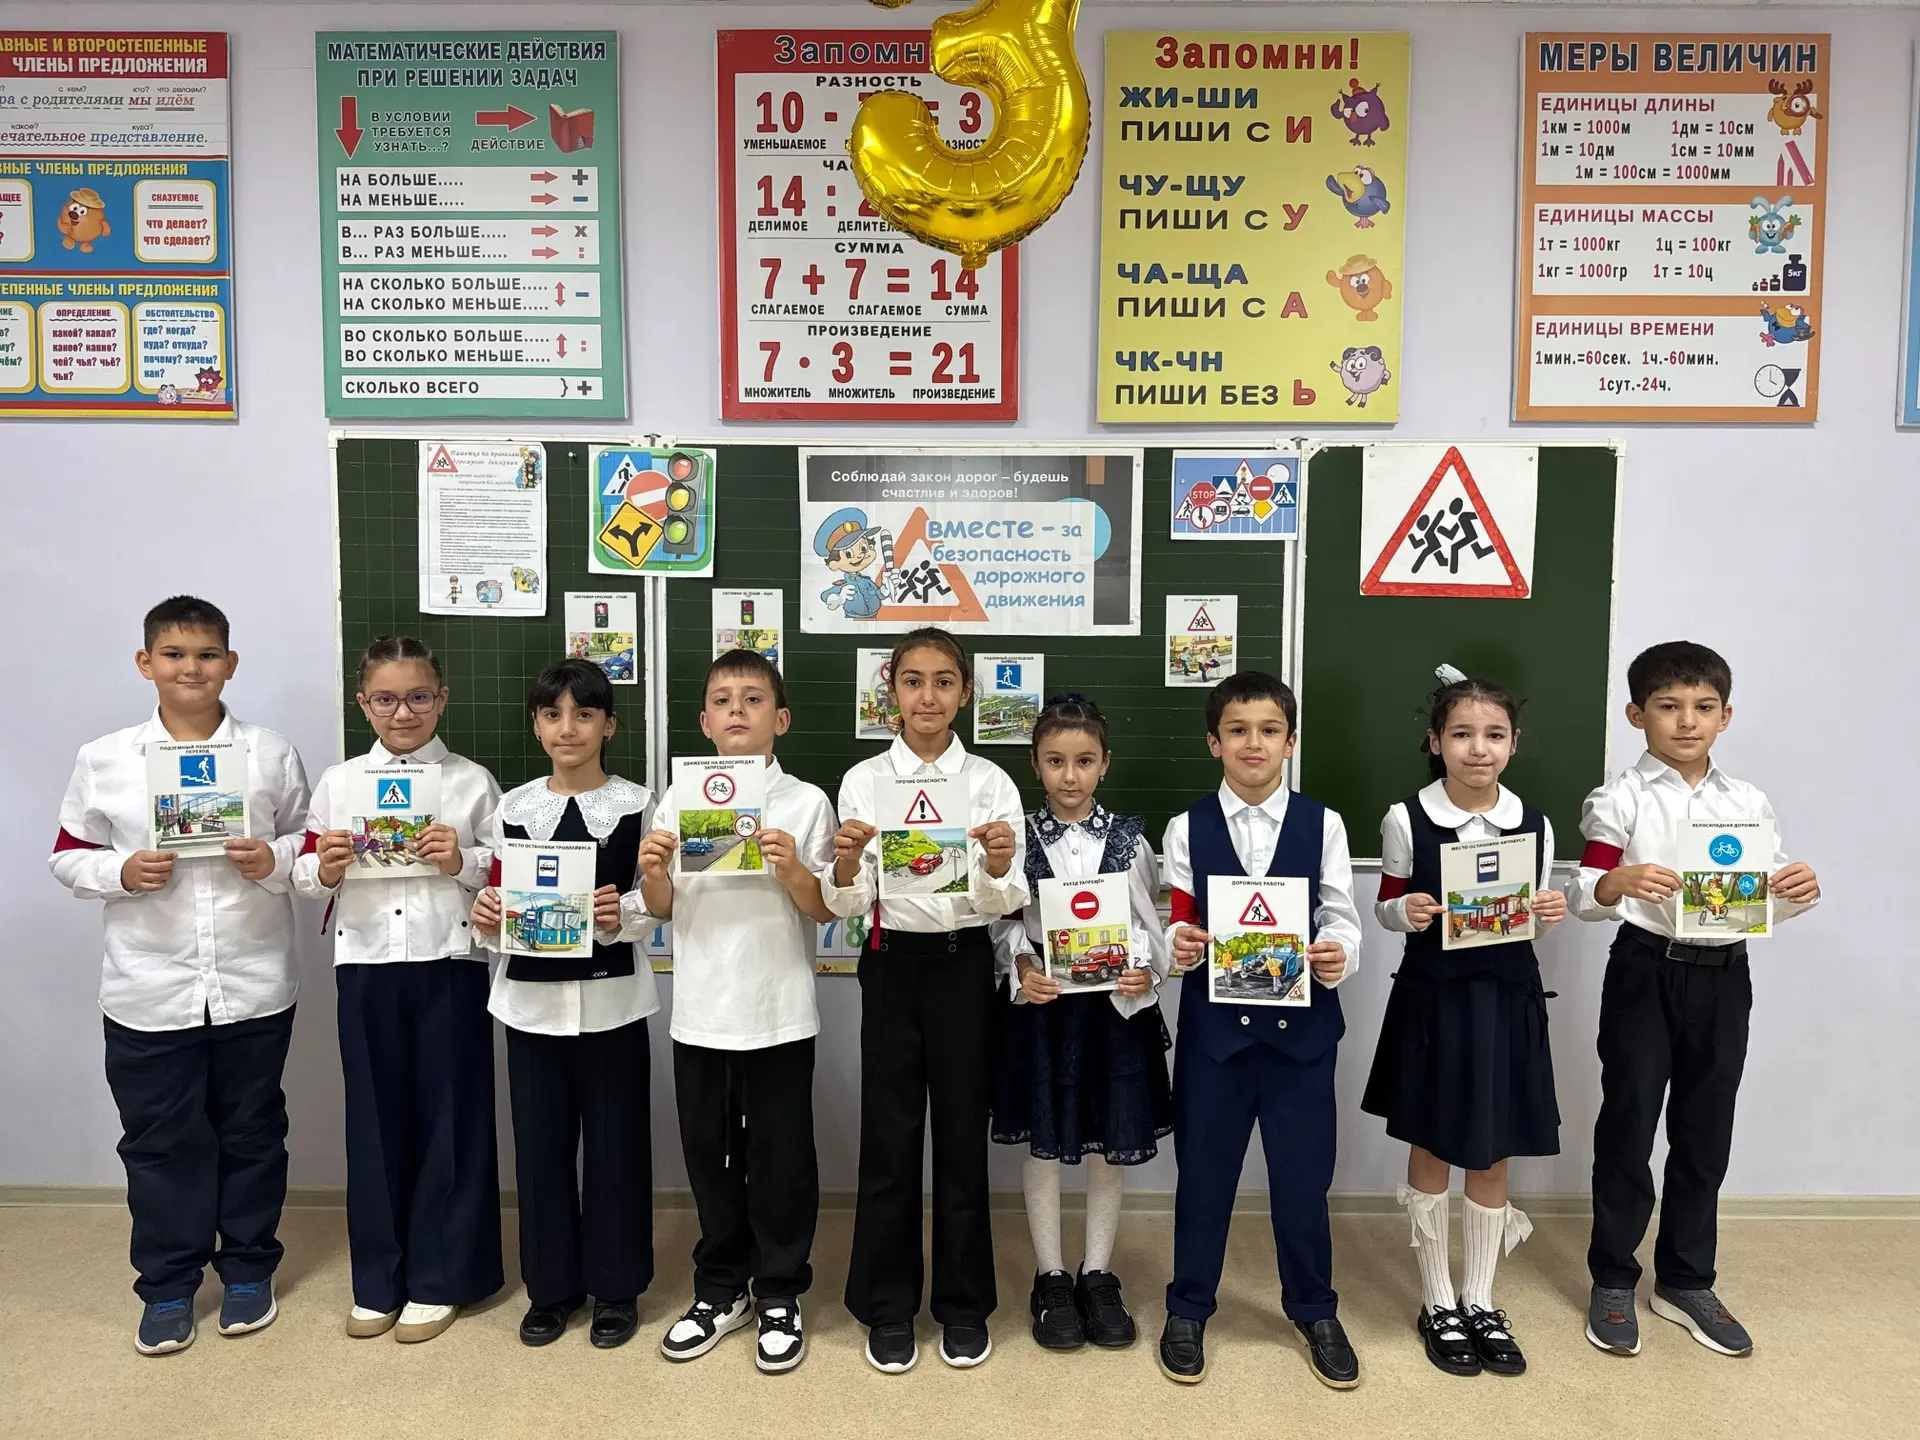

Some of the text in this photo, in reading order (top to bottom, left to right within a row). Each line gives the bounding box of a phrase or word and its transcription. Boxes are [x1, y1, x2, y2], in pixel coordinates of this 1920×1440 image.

[53, 38, 206, 53] И ВТОРОСТЕПЕННЫЕ
[328, 38, 606, 63] МАТЕМАТИЧЕСКИЕ ДЕЙСТВИЯ
[773, 35, 925, 64] Запомн
[1154, 36, 1359, 70] Запомни!
[1539, 42, 1818, 73] МЕРЫ ВЕЛИЧИН
[12, 57, 207, 74] ЧЛЕНЫ ПРЕДЛОЖЕНИЯ
[357, 68, 578, 90] ПРИ РЕШЕНИИ ЗАДАЧ
[816, 76, 922, 88] РАЗНОСТЬ
[20, 94, 194, 107] с родителями мы идём
[1118, 86, 1258, 109] ЖИ-ШИ
[756, 91, 804, 133] 10
[958, 91, 982, 133] 3
[1541, 98, 1715, 114] ЕДИНИЦЫ ДЛИНЫ
[371, 111, 451, 123] В УСЛОВИИ
[371, 126, 451, 138] ТРЕБУЕТСЯ
[1121, 121, 1230, 142] ПИШИ
[1285, 115, 1313, 143] И
[1542, 120, 1631, 134] 1км 1000м
[1672, 120, 1754, 138] 1дм 10см
[0, 131, 208, 144] ечательное представление.
[743, 138, 827, 150] УМЕНЬШАЕМОЕ
[941, 139, 986, 150] АЗНОСТ
[373, 140, 449, 153] УЗНАТЬ...?
[470, 138, 545, 152] ДЕЙСТВИЕ
[36, 163, 83, 174] ЧЛЕНЫ
[88, 164, 187, 176] ПРЕДЛОЖЕНИЯ
[340, 173, 361, 186] НА
[1119, 174, 1246, 201] ЧУ-ЩУ
[151, 193, 199, 202] СКАЗУЕМОЕ
[757, 175, 806, 216] 14
[1539, 209, 1714, 224] ЕДИНИЦЫ МАССЫ
[374, 226, 404, 238] РАЗ
[748, 220, 808, 233] ДЕЛИМОЕ
[838, 220, 897, 233] ДЕЛИТЕЛ
[834, 242, 904, 254] СУММА
[1539, 237, 1620, 251] 1т 1000кг
[1656, 238, 1731, 254] 1ц 100кг
[760, 258, 979, 300] 7 7 14
[1117, 263, 1248, 289] ЧА-ЩА
[1788, 268, 1802, 277] 5кг
[0, 283, 218, 298] ЕПЕННЫЕ ЧЛЕНЫ ПРЕДЛОЖЕНИЯ
[343, 278, 365, 290] НА
[370, 278, 445, 290] СКОЛЬКО
[56, 309, 111, 318] ОПРЕДЕЛЕНИЕ
[145, 309, 214, 318] ОБСТОЯТЕЛЬСТВО
[751, 304, 988, 316] СЛАГАЕМОЕ СЛАГАЕМОЕ СУММА
[53, 328, 116, 337] какой? какая?
[143, 325, 196, 336] где? когда?
[807, 326, 932, 338] ПРОИЗВЕДЕНИЕ
[1535, 322, 1714, 337] ЕДИНИЦЫ ВРЕМЕНИ
[344, 350, 366, 362] ВО
[373, 350, 447, 361] СКОЛЬКО
[759, 341, 980, 383] 7 3 21
[1115, 351, 1223, 372] ЧК-ЧН
[345, 381, 479, 394] СКОЛЬКО ВСЕГО
[744, 387, 996, 400] МНОЖИТЕЛЬ МНОЖИТЕЛЬ ПРОИЗВЕДЕНИЕ
[1115, 379, 1317, 406] ПИШИ БЕЗ Ь
[831, 470, 1069, 485] Соблюдай закон дорог будешь
[882, 487, 1018, 500] счастлив и здоров!
[1192, 490, 1215, 500] STOP
[928, 519, 1082, 540] вместе за
[932, 545, 1071, 563] безопасность
[973, 570, 1085, 588] дорожного
[984, 592, 1085, 610] движения
